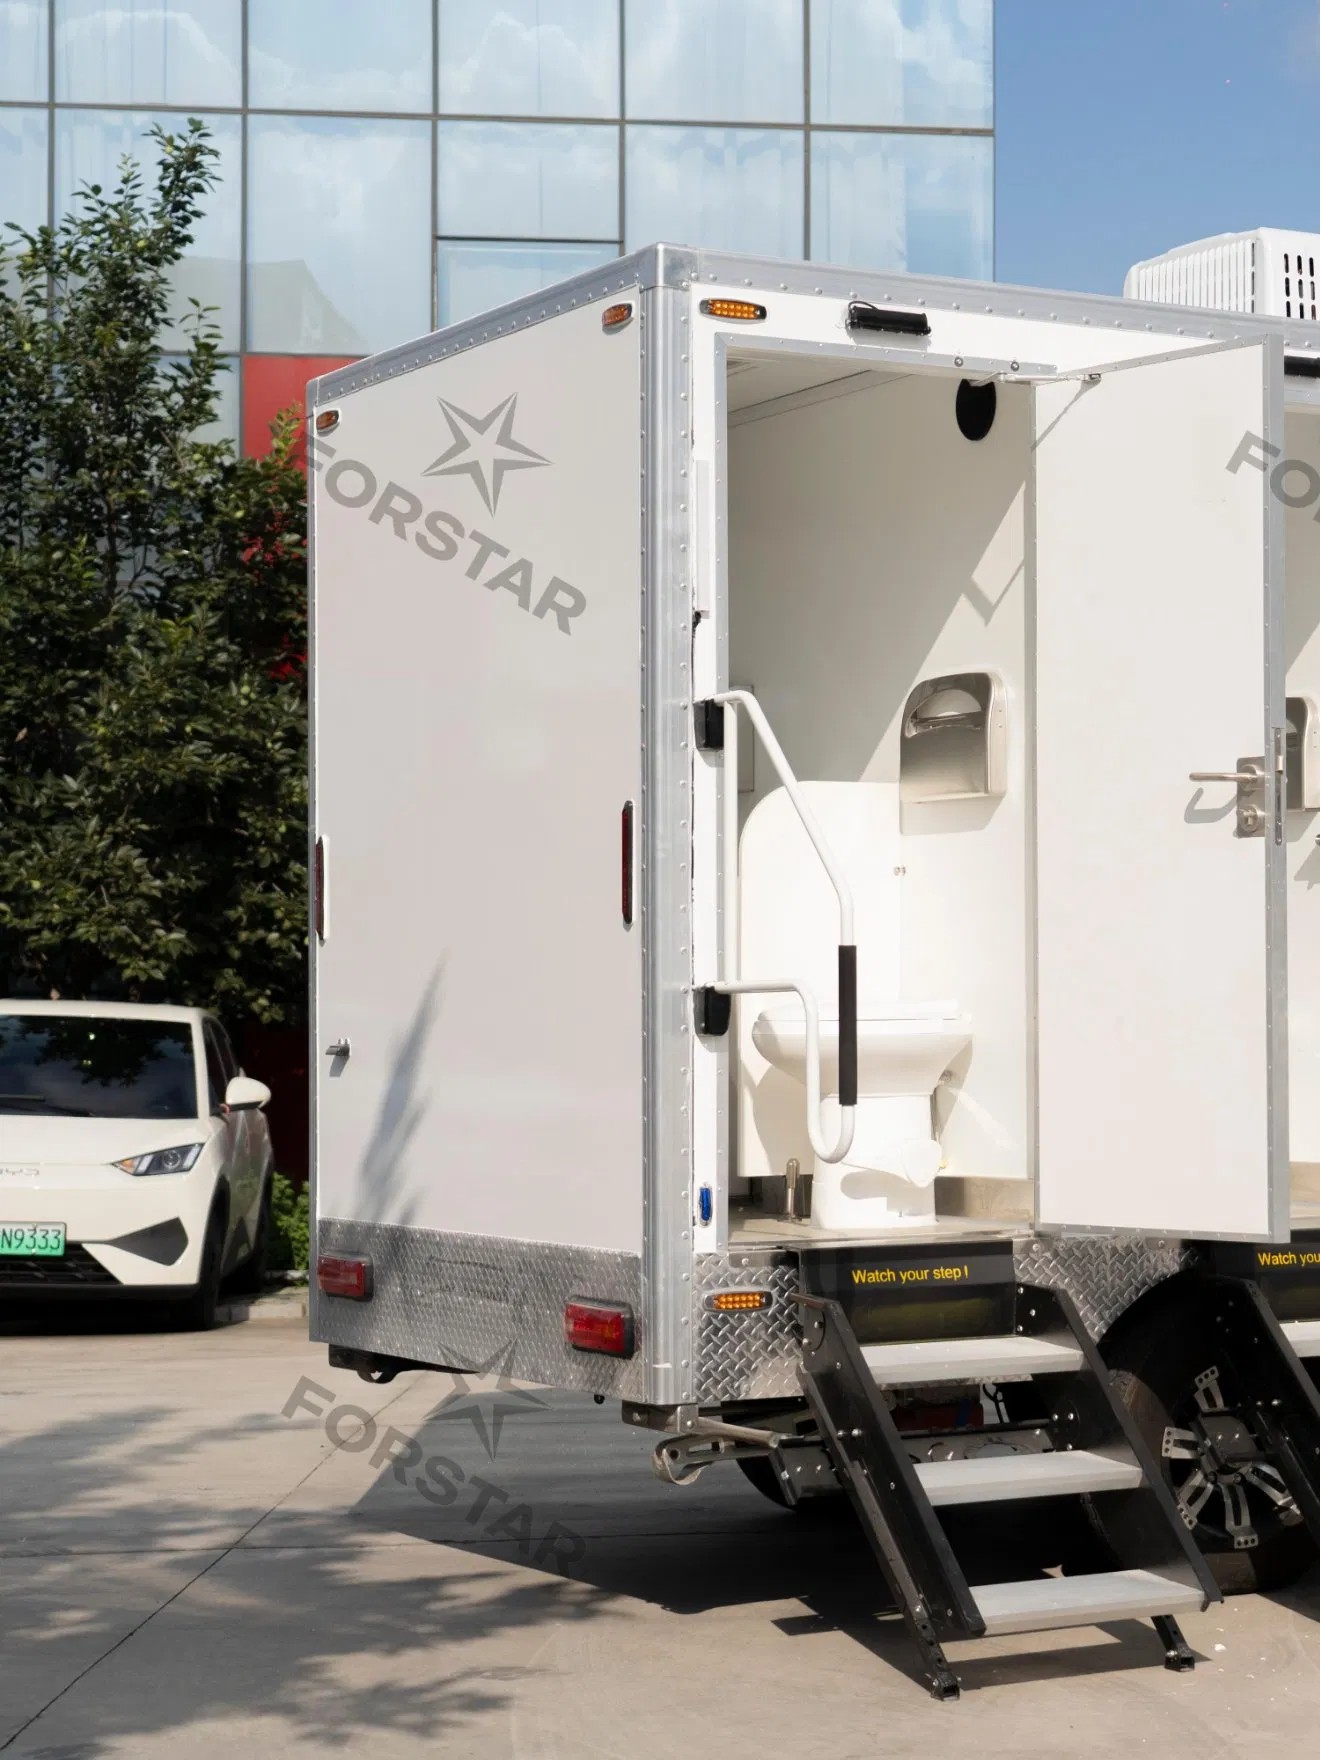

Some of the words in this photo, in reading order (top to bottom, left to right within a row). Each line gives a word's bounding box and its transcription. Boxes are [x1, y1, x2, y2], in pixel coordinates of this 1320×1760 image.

[1257, 1251, 1297, 1266] Watch
[852, 1268, 896, 1284] Watch
[899, 1269, 929, 1284] your
